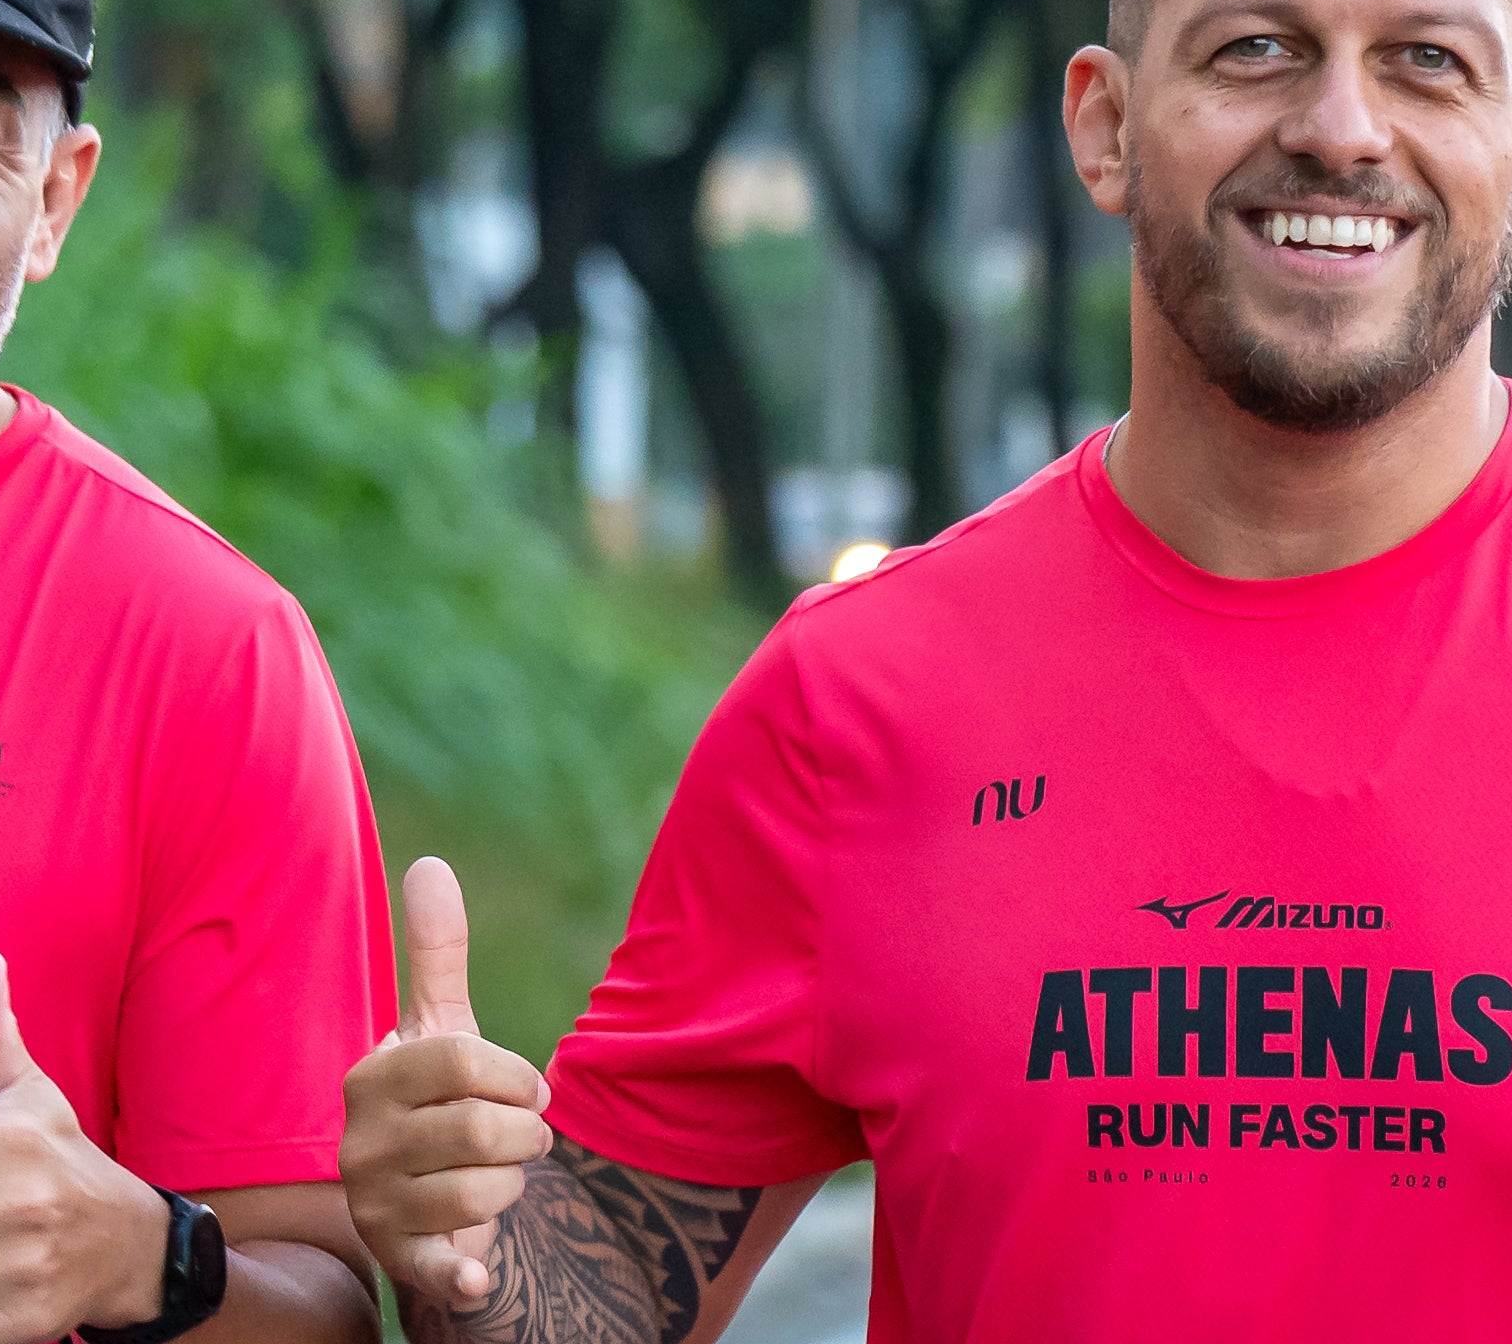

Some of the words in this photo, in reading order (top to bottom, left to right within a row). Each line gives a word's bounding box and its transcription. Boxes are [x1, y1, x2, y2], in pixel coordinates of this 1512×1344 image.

[1087, 1104, 1211, 1150] RUN
[1228, 1104, 1447, 1153] FASTER
[1143, 1170, 1209, 1184] Paulo
[1390, 1173, 1447, 1189] 2026
